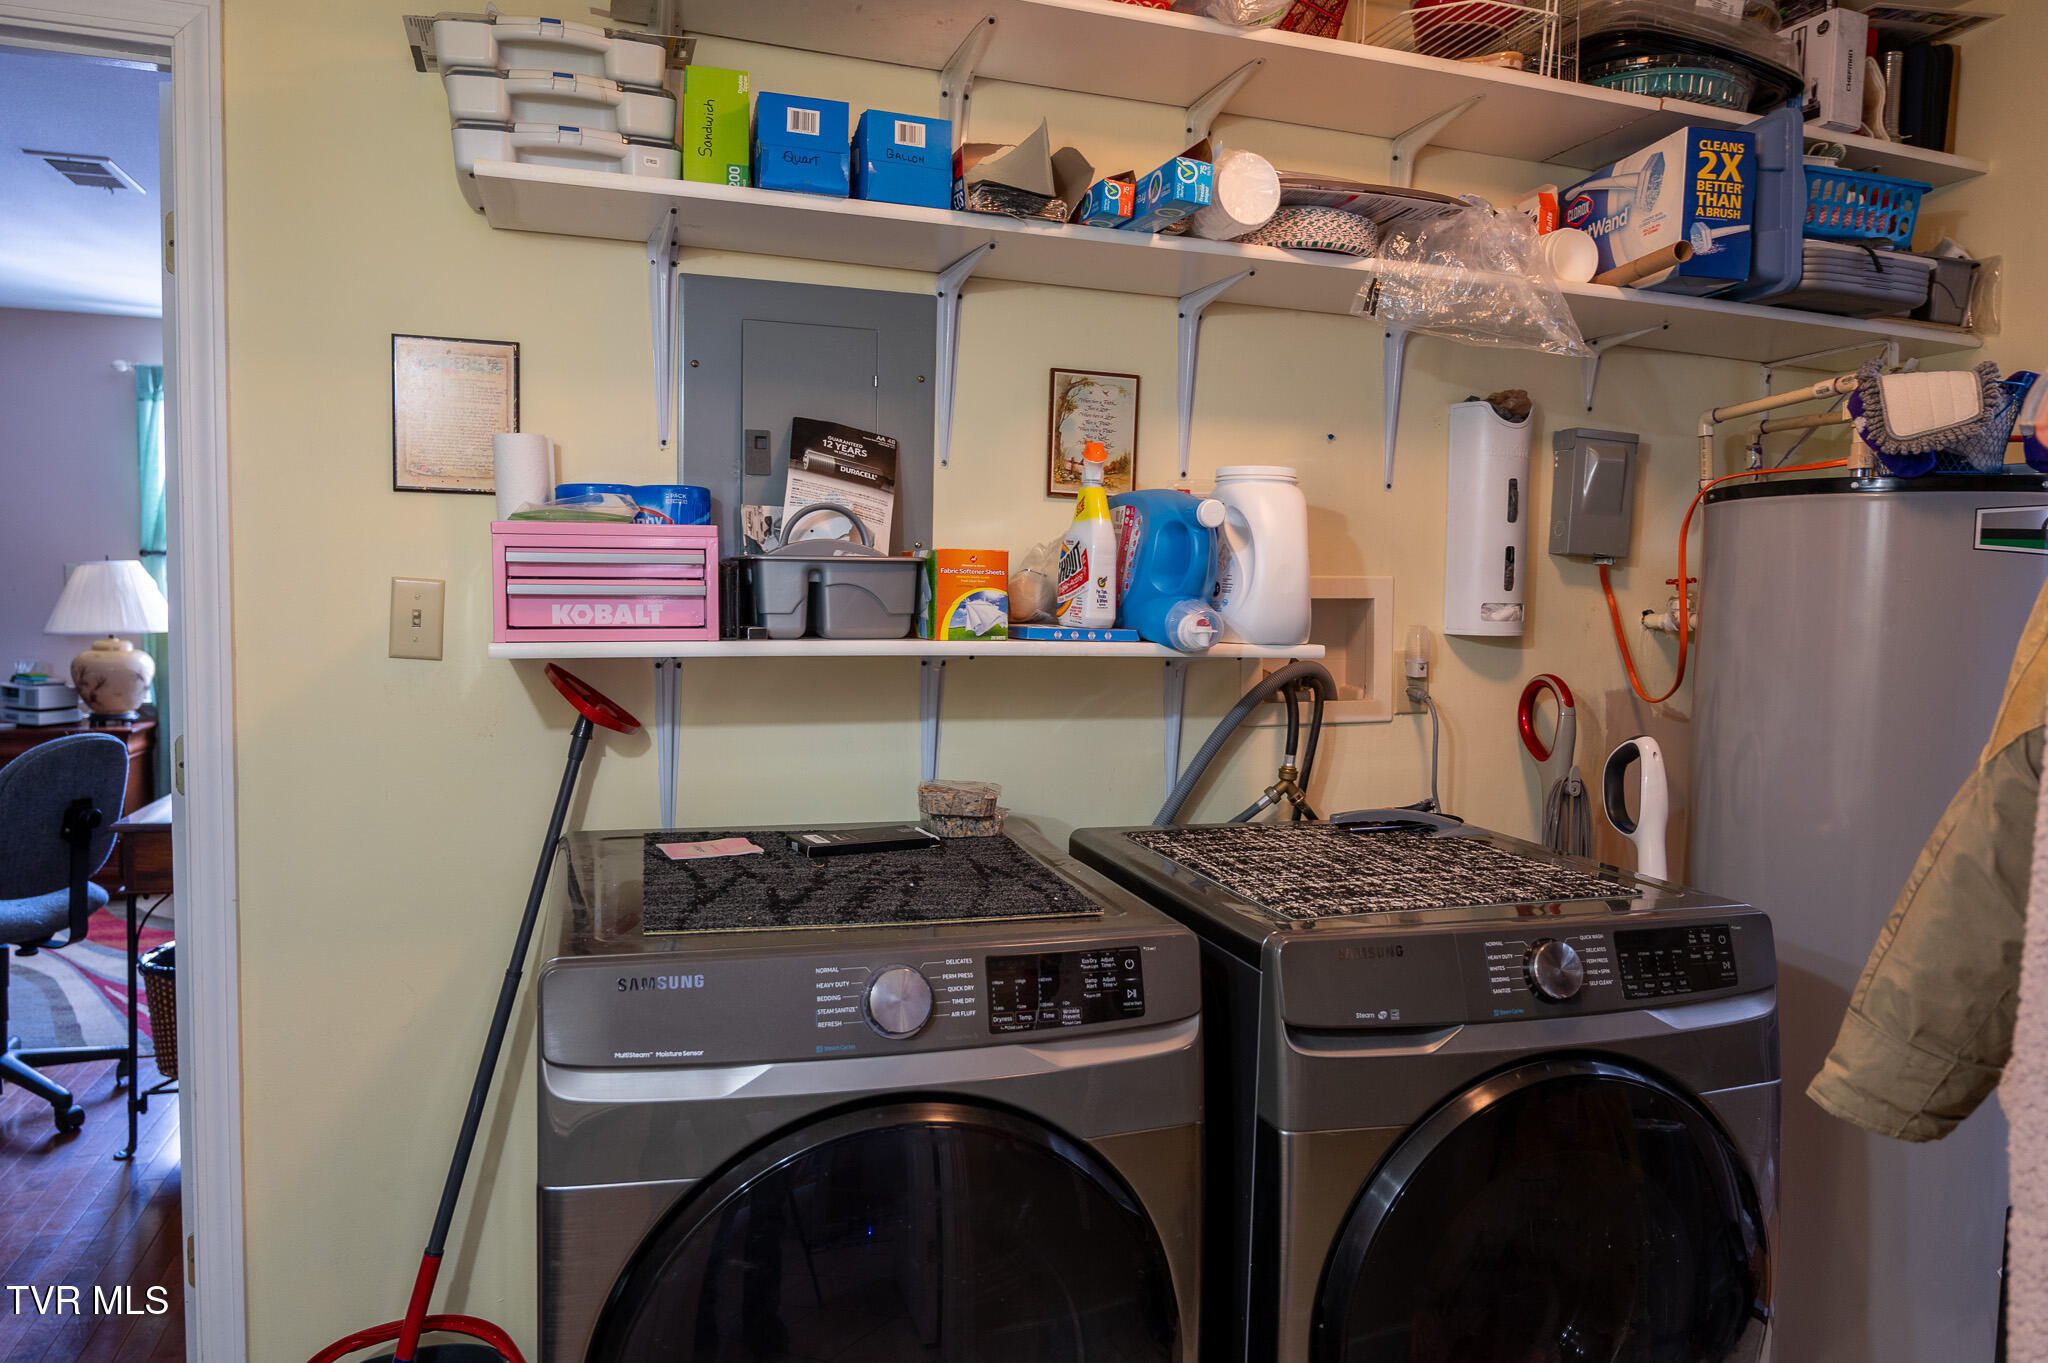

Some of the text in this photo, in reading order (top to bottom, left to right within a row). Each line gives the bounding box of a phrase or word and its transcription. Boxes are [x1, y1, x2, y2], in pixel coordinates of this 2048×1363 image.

[697, 99, 715, 157] Sandwich
[1699, 139, 1745, 153] CLEANS
[1200, 165, 1207, 175] 75
[1697, 150, 1743, 182] 2X
[1696, 180, 1742, 194] BETTER
[1696, 191, 1742, 209] THAN
[1567, 202, 1590, 222] CLOROX
[1695, 206, 1741, 219] A BRUSH
[822, 439, 833, 449] 12
[835, 441, 868, 458] YEARS
[827, 435, 864, 449] GUARANTEED
[840, 466, 877, 480] DURACELL
[552, 604, 664, 625] KOBALT
[617, 974, 705, 992] SAMSUNG
[655, 1050, 683, 1058] Moisture
